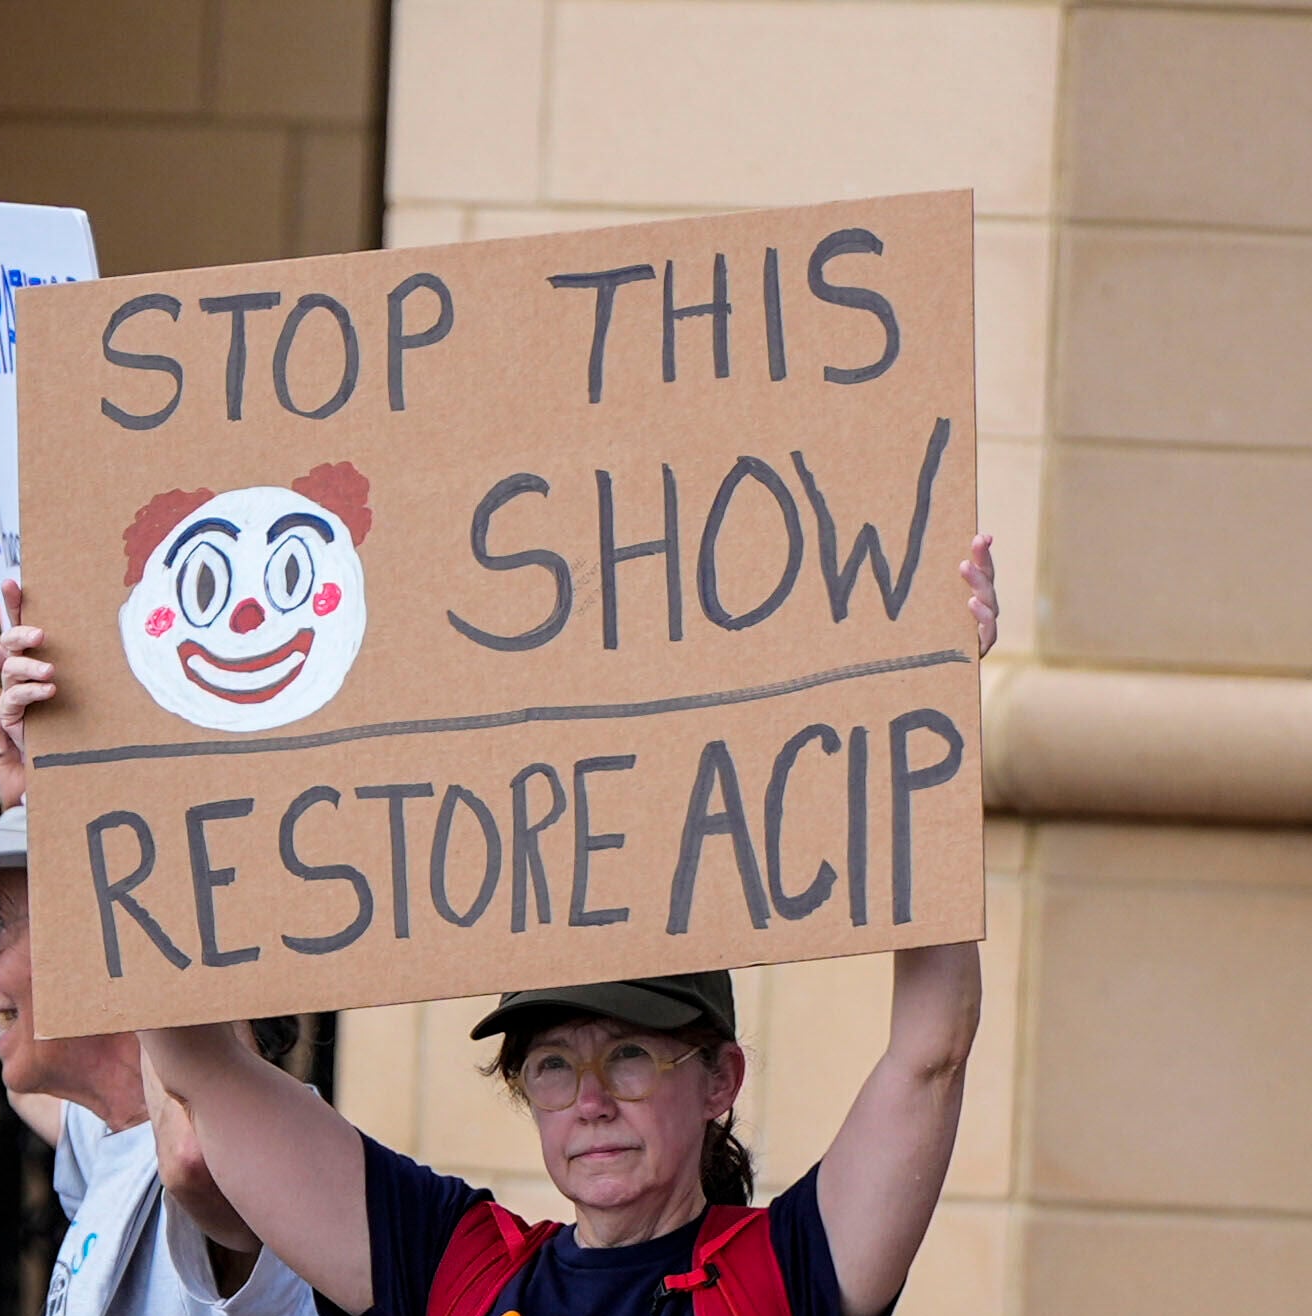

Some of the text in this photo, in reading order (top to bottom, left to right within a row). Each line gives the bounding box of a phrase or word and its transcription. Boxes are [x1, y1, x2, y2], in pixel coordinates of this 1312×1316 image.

[100, 271, 455, 431] STOP
[548, 227, 901, 404] THIS
[446, 417, 950, 652] SHOW
[86, 708, 963, 980] RESTORE ACIP
